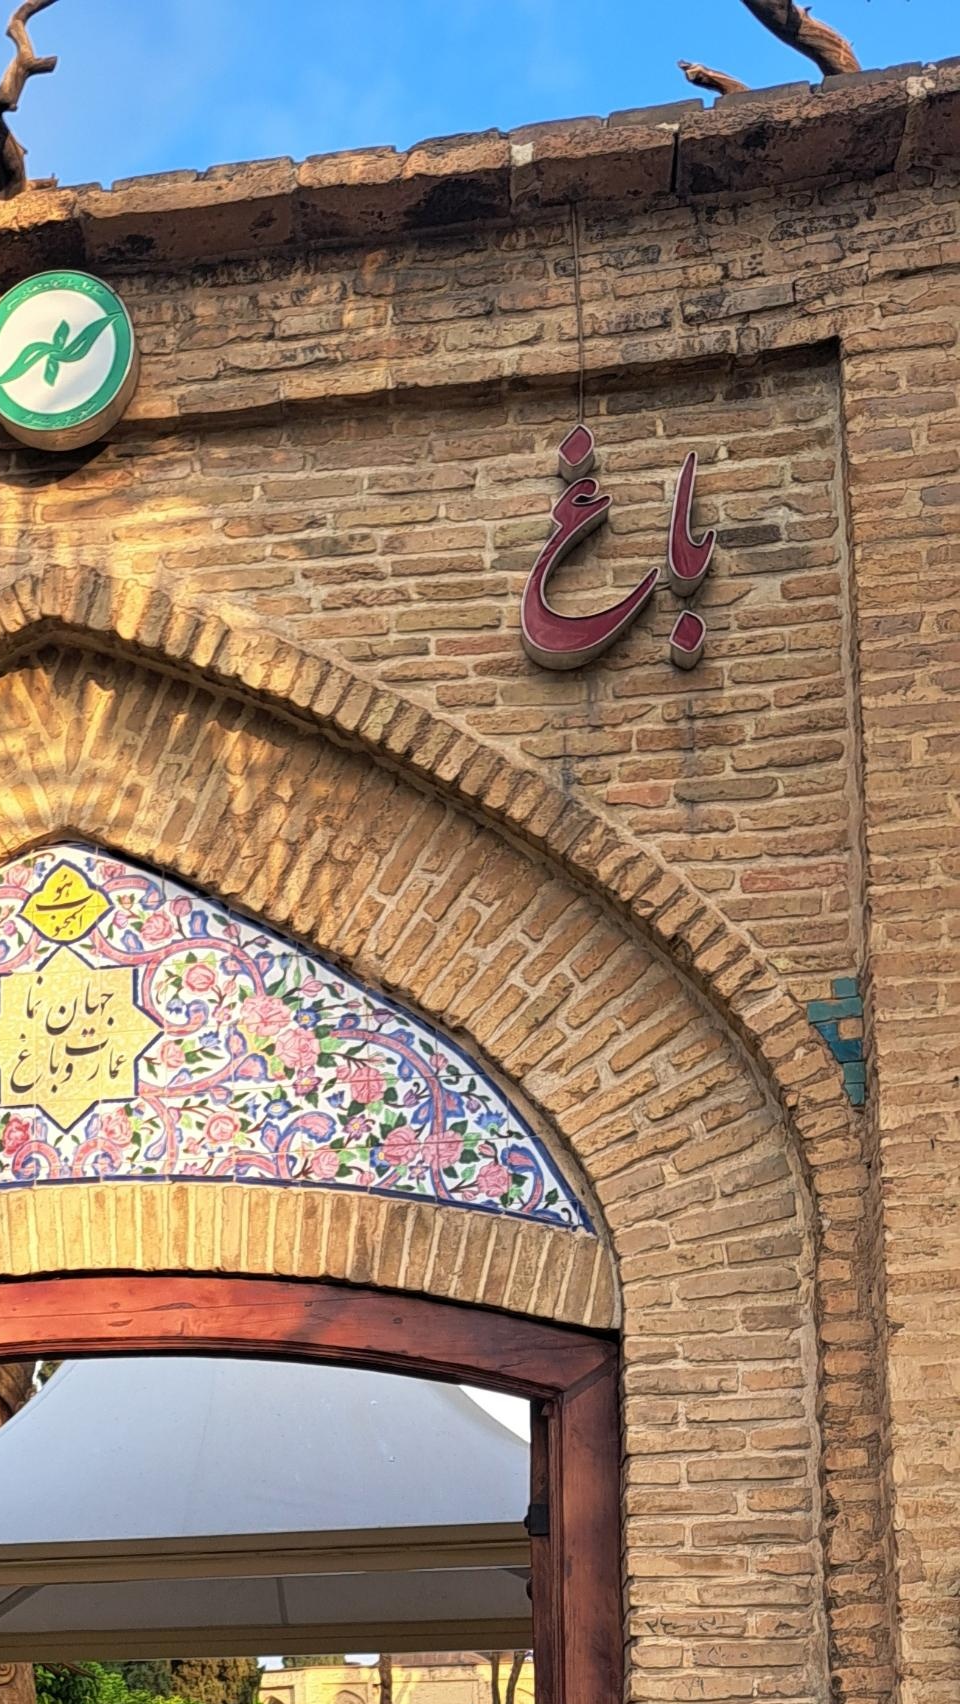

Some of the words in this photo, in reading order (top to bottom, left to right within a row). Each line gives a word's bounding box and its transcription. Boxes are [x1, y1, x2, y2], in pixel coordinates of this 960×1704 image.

[520, 424, 717, 655] باغ
[26, 975, 43, 1019] نما
[45, 981, 115, 1036] جهان
[10, 1033, 60, 1093] باغ
[65, 1027, 128, 1080] عمارت
